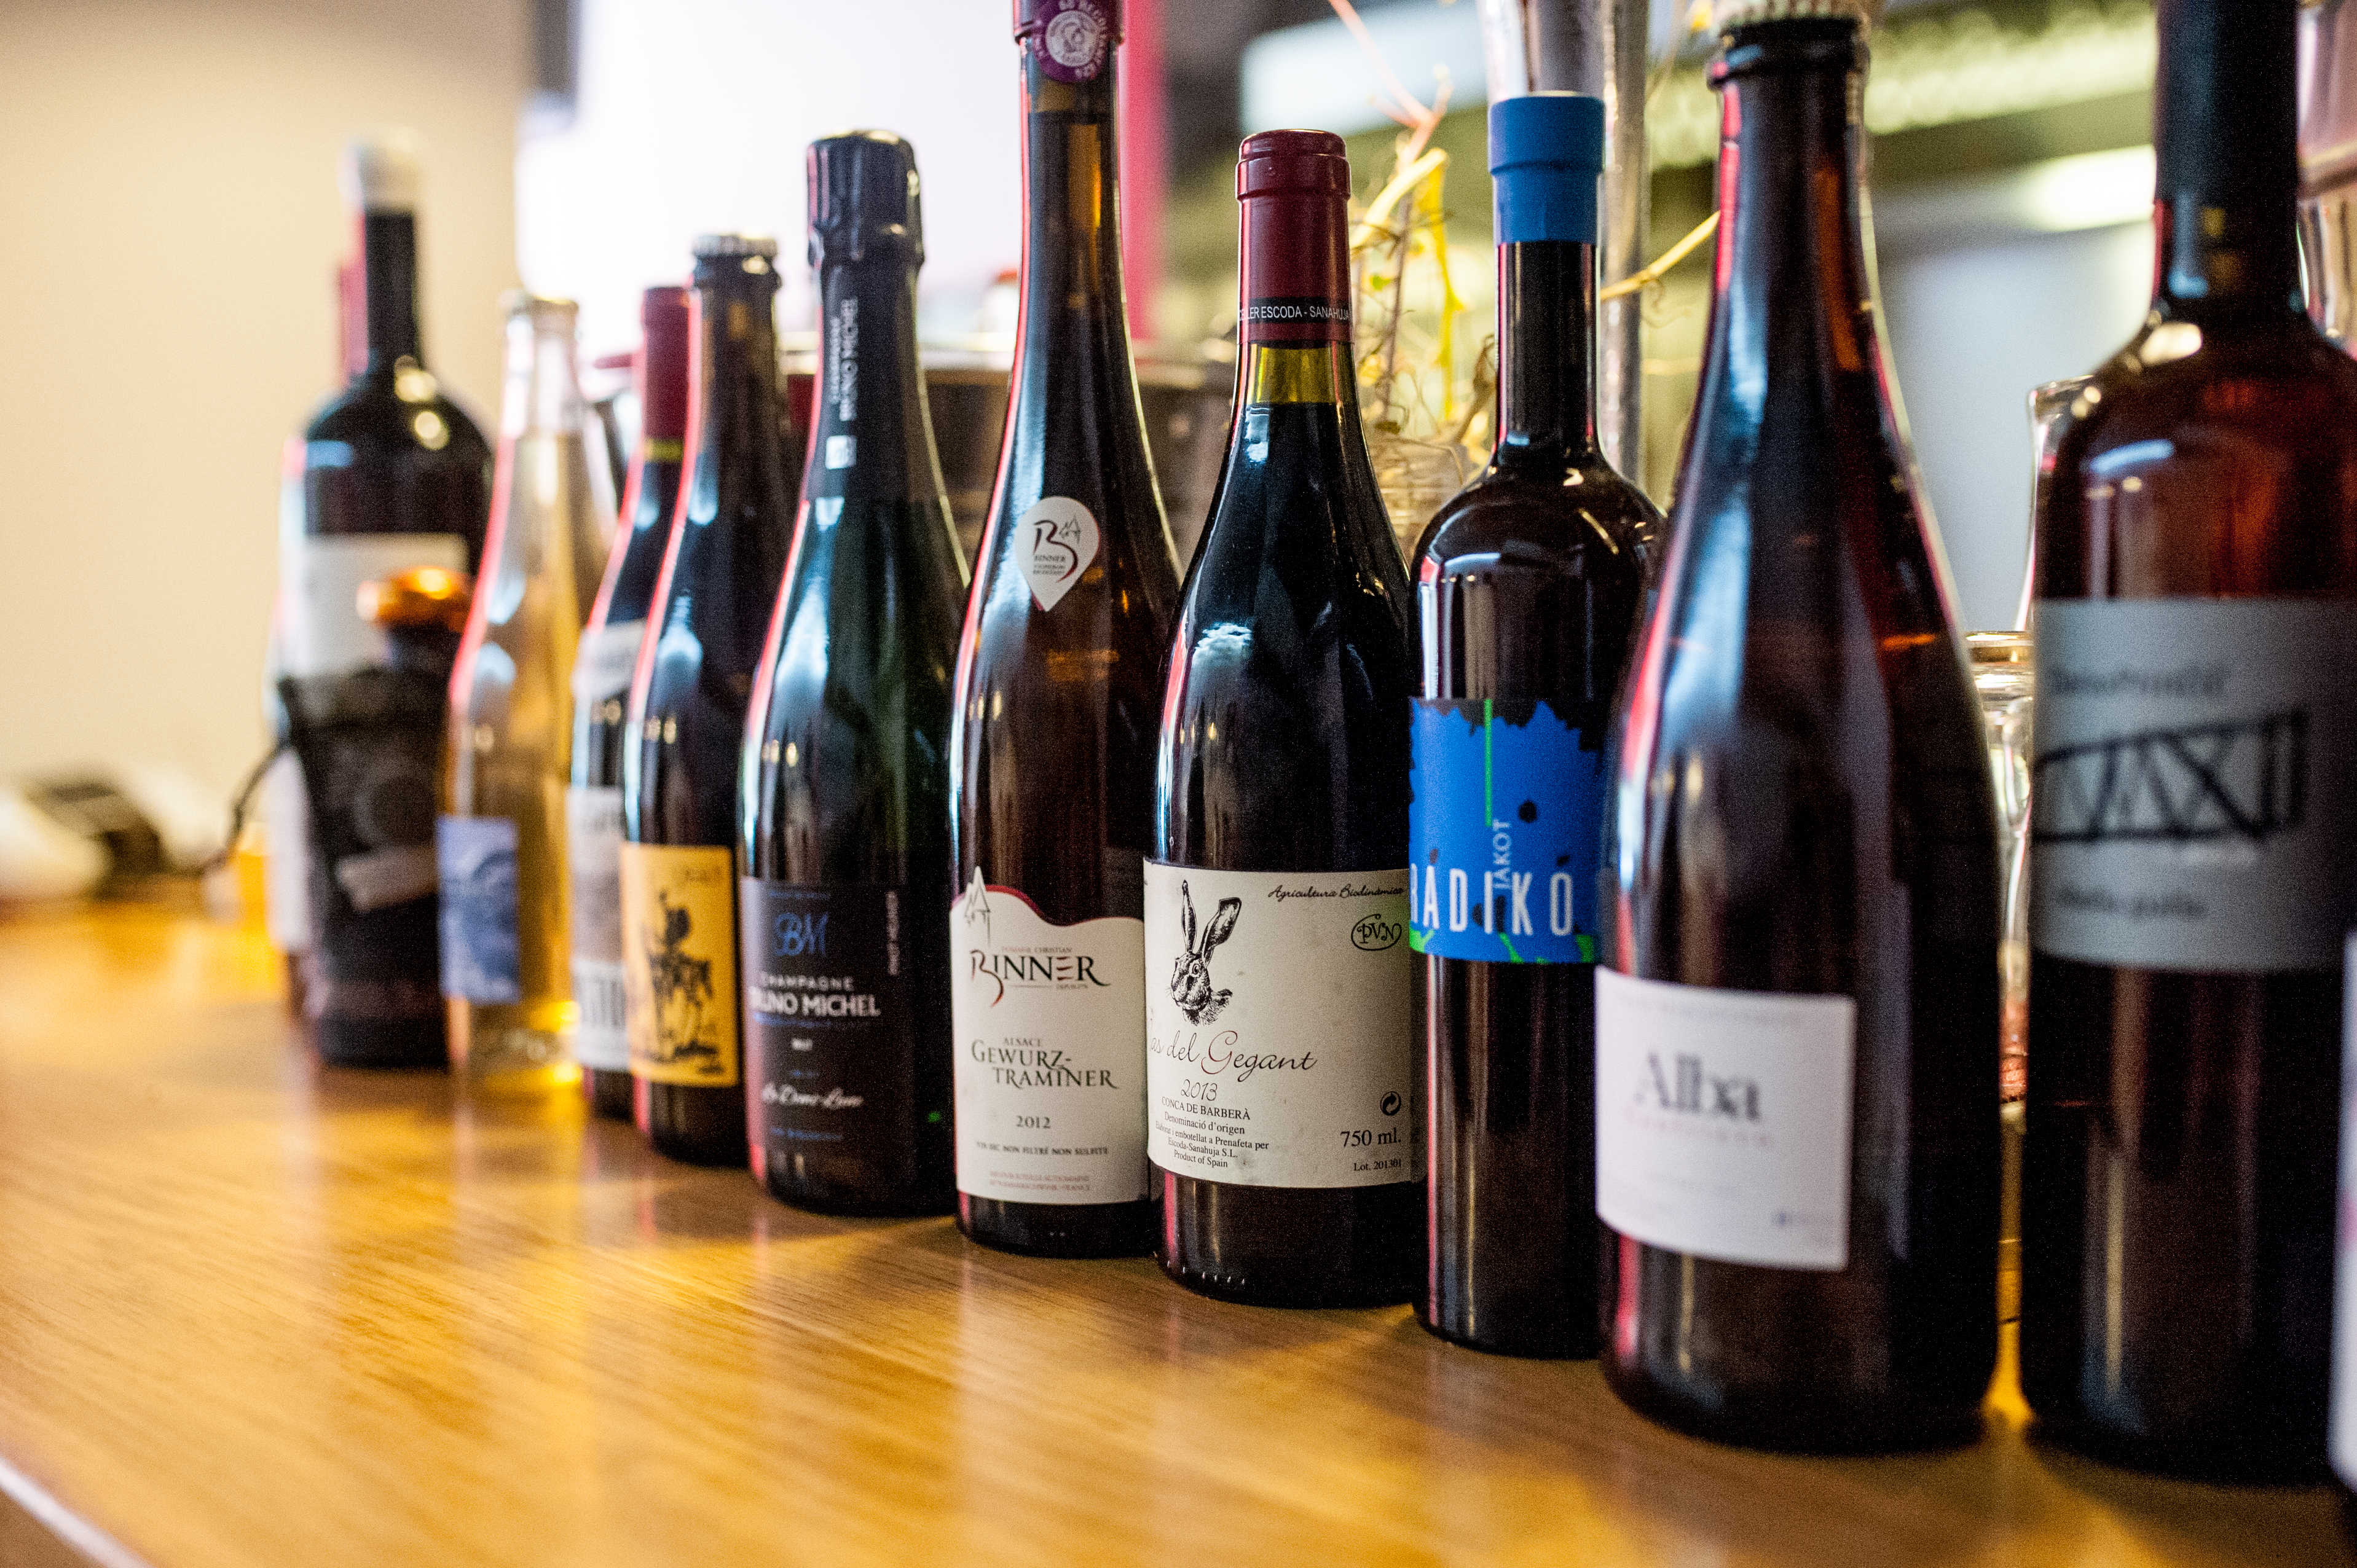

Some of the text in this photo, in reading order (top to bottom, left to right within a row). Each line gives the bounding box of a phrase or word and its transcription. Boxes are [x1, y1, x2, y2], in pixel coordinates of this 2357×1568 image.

[1261, 306, 1302, 319] ESCODA
[1268, 884, 1337, 902] Agricultura
[970, 949, 1112, 1008] BINNER
[802, 994, 881, 1017] MICHEL
[1004, 1037, 1043, 1048] ALSACE
[1167, 1030, 1200, 1063] del
[1200, 1030, 1318, 1083] Gegant
[993, 1065, 1120, 1089] TRAMINER
[1634, 1053, 1761, 1122] Alba
[1180, 1078, 1218, 1102] 2013
[1161, 1096, 1251, 1121] CONCA DE BARBERÀ
[1015, 1115, 1052, 1130] 2012
[1165, 1111, 1206, 1130] Denominació
[1215, 1136, 1253, 1150] Prenafeta
[1255, 1142, 1270, 1152] per
[1340, 1127, 1402, 1148] 750 ml.
[1174, 1149, 1196, 1163] Product
[1207, 1158, 1229, 1169] Spain
